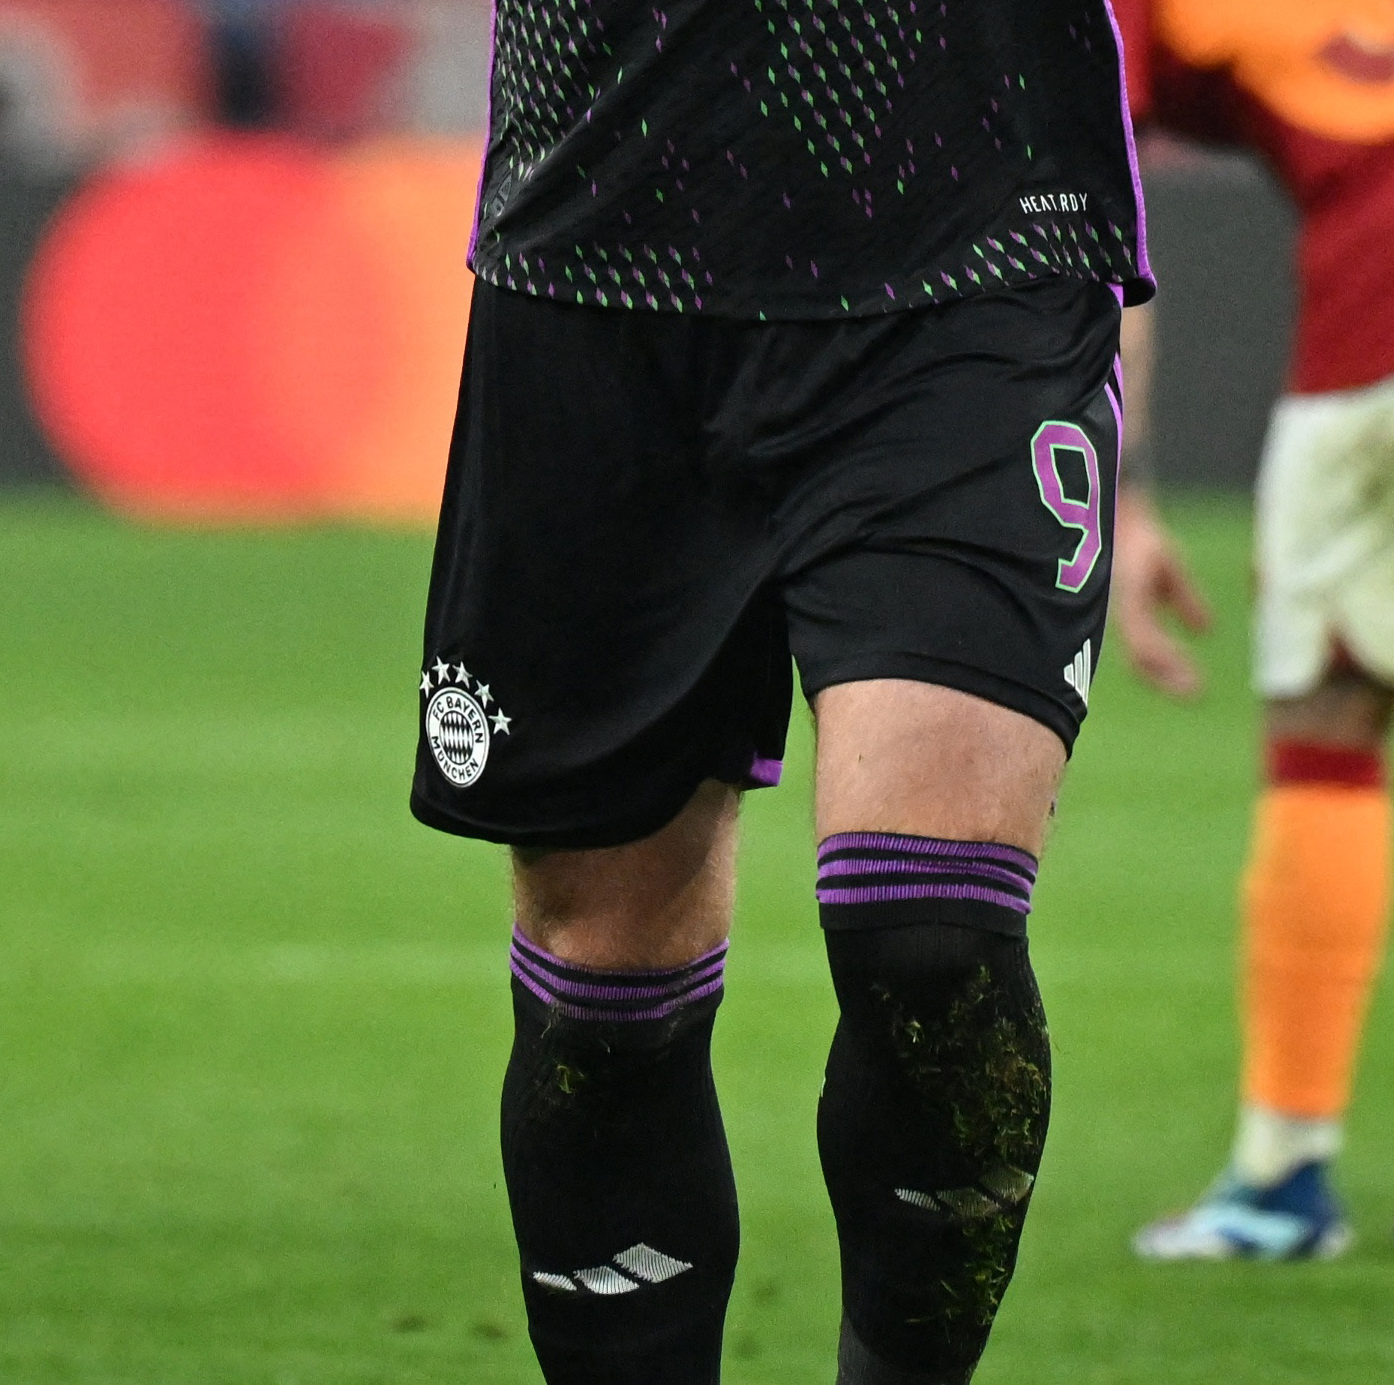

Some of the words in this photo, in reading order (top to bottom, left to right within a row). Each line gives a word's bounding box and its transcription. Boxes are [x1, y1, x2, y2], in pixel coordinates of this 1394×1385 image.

[1019, 192, 1088, 214] HEAT.RDY
[1030, 420, 1102, 594] 9
[432, 701, 445, 722] FC
[445, 695, 484, 744] BAYERN
